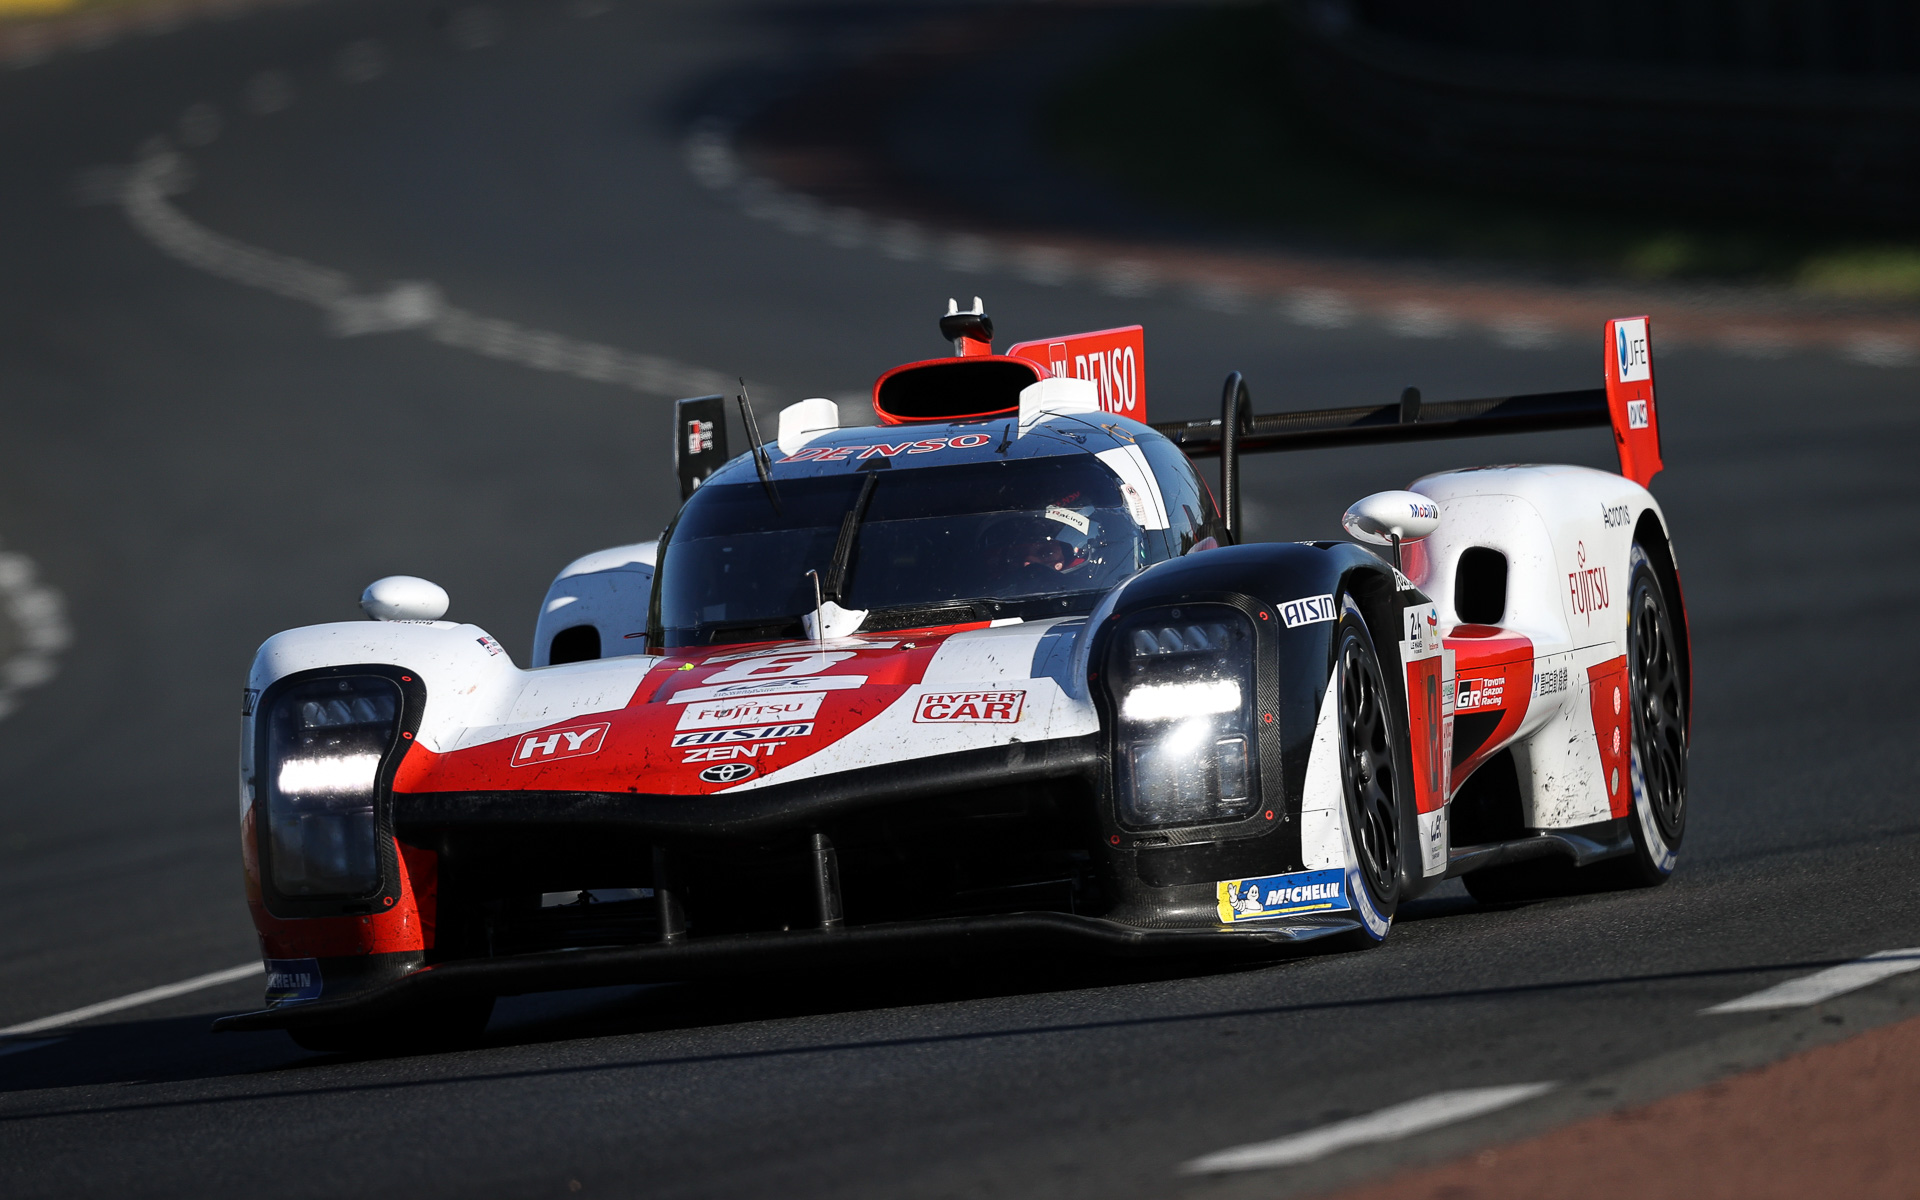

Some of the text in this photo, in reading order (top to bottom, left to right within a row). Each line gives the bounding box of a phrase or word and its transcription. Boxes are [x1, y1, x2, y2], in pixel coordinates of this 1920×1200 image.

[1629, 338, 1646, 366] JFE
[775, 433, 992, 464] DENSO
[1409, 503, 1432, 518] Mobil
[1600, 502, 1631, 530] Acronis
[1568, 566, 1610, 628] FUJITSU
[1284, 597, 1335, 625] AISIN
[700, 651, 858, 684] 8
[1482, 687, 1504, 697] GAZOO
[1483, 677, 1506, 687] TOYOTA
[926, 693, 1017, 704] HYPER
[1457, 690, 1481, 708] GR
[1481, 696, 1502, 706] Racing
[697, 702, 804, 720] FUJITSU
[922, 702, 1013, 719] CAR
[519, 727, 602, 760] HY
[675, 724, 809, 746] AISIN
[681, 741, 787, 763] ZENT
[1264, 882, 1340, 906] MICHELIN
